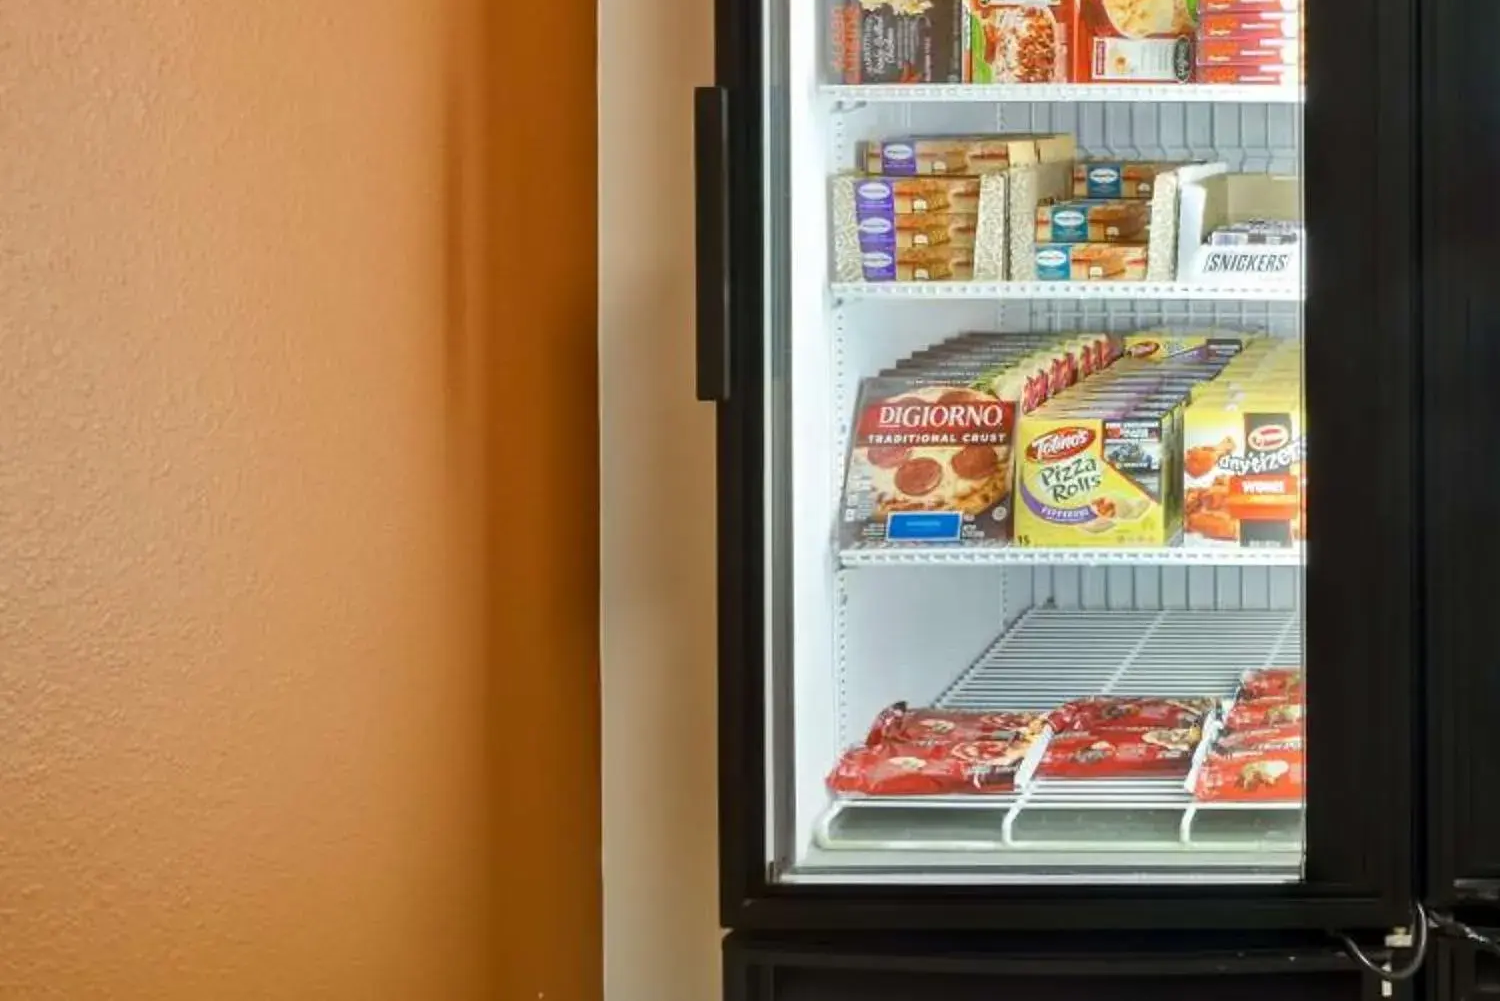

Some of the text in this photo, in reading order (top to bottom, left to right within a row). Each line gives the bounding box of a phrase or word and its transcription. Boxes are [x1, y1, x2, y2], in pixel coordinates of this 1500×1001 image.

[1208, 253, 1288, 272] SNICKERS
[879, 404, 1004, 428] DIGIORNO
[868, 433, 1007, 444] TRADITIONAL CRUST
[1041, 458, 1097, 487] Pizza
[1051, 474, 1101, 503] Rolls
